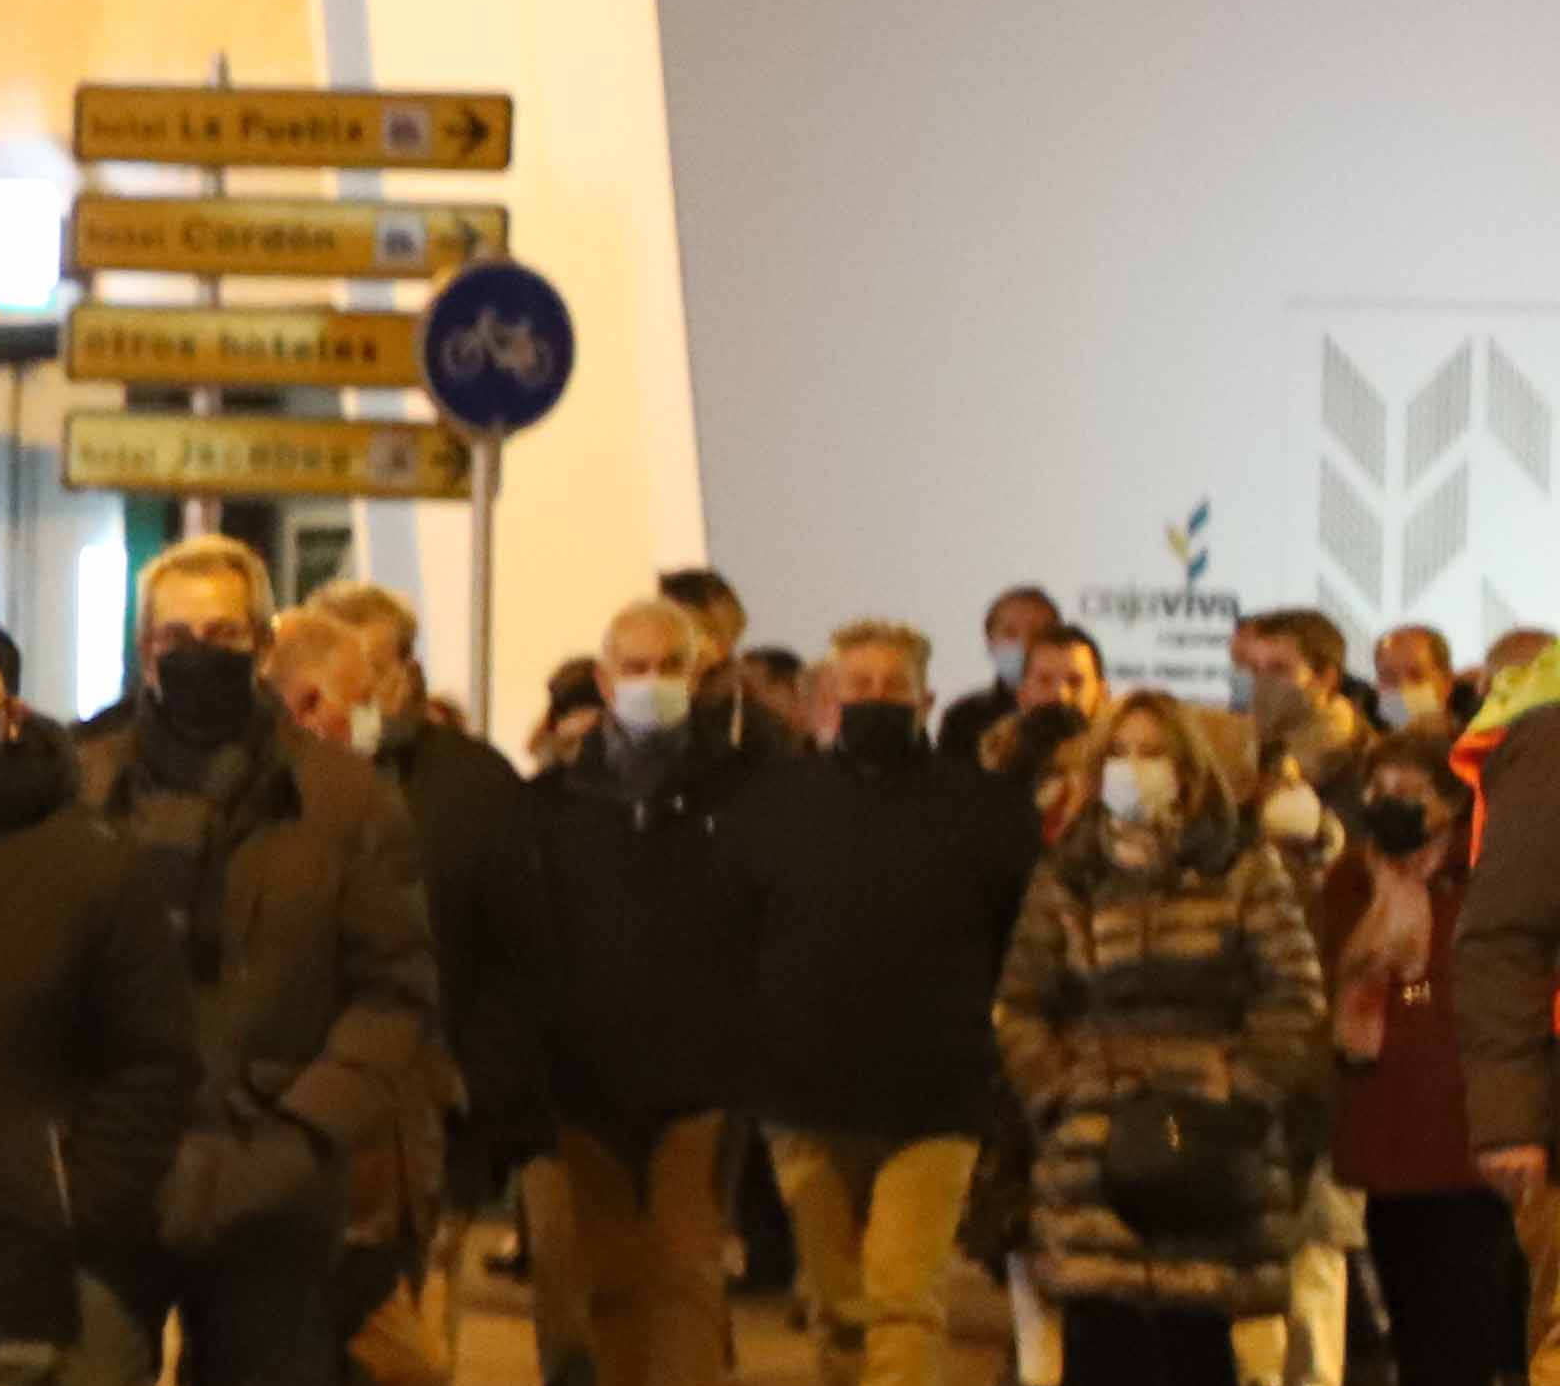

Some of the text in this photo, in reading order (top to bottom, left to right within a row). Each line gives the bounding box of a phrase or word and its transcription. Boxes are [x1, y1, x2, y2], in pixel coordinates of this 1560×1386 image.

[178, 107, 222, 143] La
[237, 104, 364, 146] Puebla
[82, 326, 380, 363] otros hoteles
